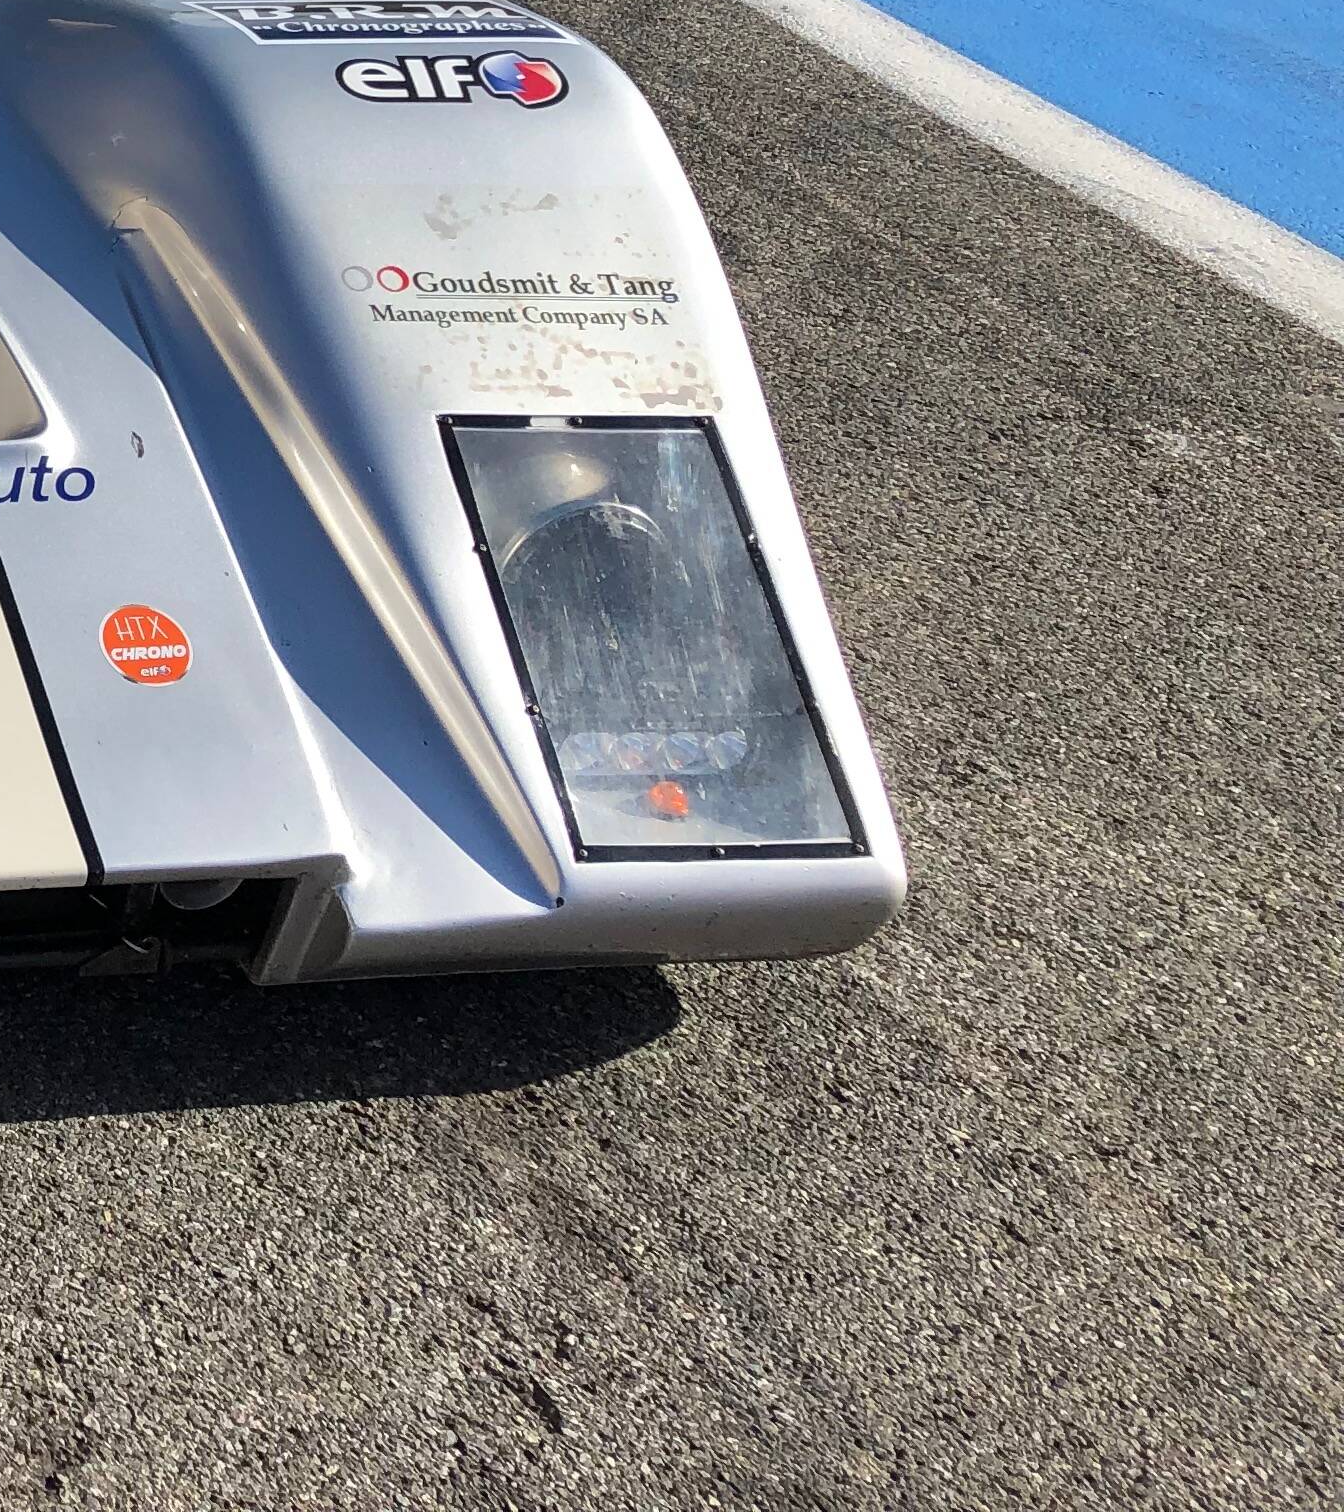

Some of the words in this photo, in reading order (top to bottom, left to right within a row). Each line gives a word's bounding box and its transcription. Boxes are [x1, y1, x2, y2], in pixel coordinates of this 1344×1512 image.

[276, 18, 526, 34] Chronographes
[342, 58, 473, 99] elf
[412, 270, 561, 295] Goudsmit
[569, 273, 595, 295] &
[597, 273, 679, 303] Tang
[368, 303, 518, 328] Management
[521, 305, 628, 330] Company
[632, 308, 670, 326] SA
[114, 615, 169, 641] HTX
[111, 644, 187, 661] CHRONO
[140, 666, 160, 677] elf
